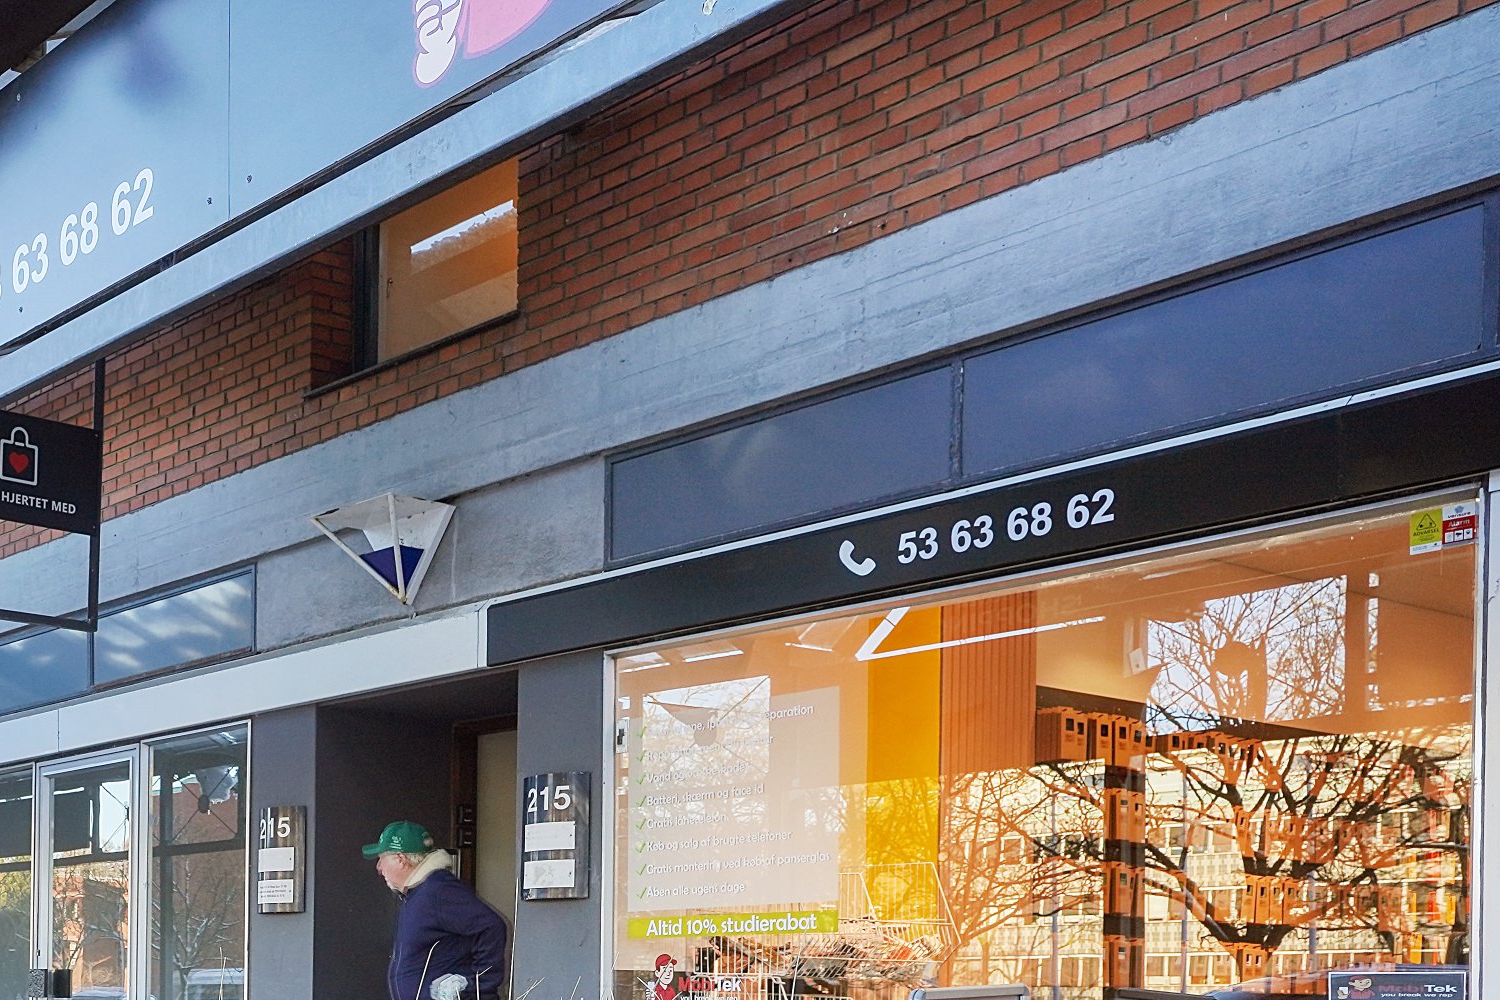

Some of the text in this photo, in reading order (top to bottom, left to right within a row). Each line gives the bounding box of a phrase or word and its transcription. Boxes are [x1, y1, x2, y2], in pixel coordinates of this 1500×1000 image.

[12, 232, 49, 293] 63
[59, 201, 99, 266] 68
[111, 168, 154, 235] 62
[1, 491, 48, 509] HJERTET
[51, 500, 76, 514] MED
[897, 488, 1115, 564] 53 63 68 62
[527, 785, 571, 813] 215
[718, 789, 729, 799] og
[732, 786, 751, 797] face
[754, 783, 764, 794] id
[260, 816, 291, 839] 215
[680, 838, 700, 850] salg
[701, 836, 712, 846] af
[714, 834, 745, 846] brugte
[647, 864, 673, 874] Gratis
[723, 857, 741, 869] ved
[778, 852, 830, 867] panserglas
[672, 885, 690, 896] alle
[691, 884, 718, 896] ugens
[646, 912, 817, 936] Altid 10% studierabat
